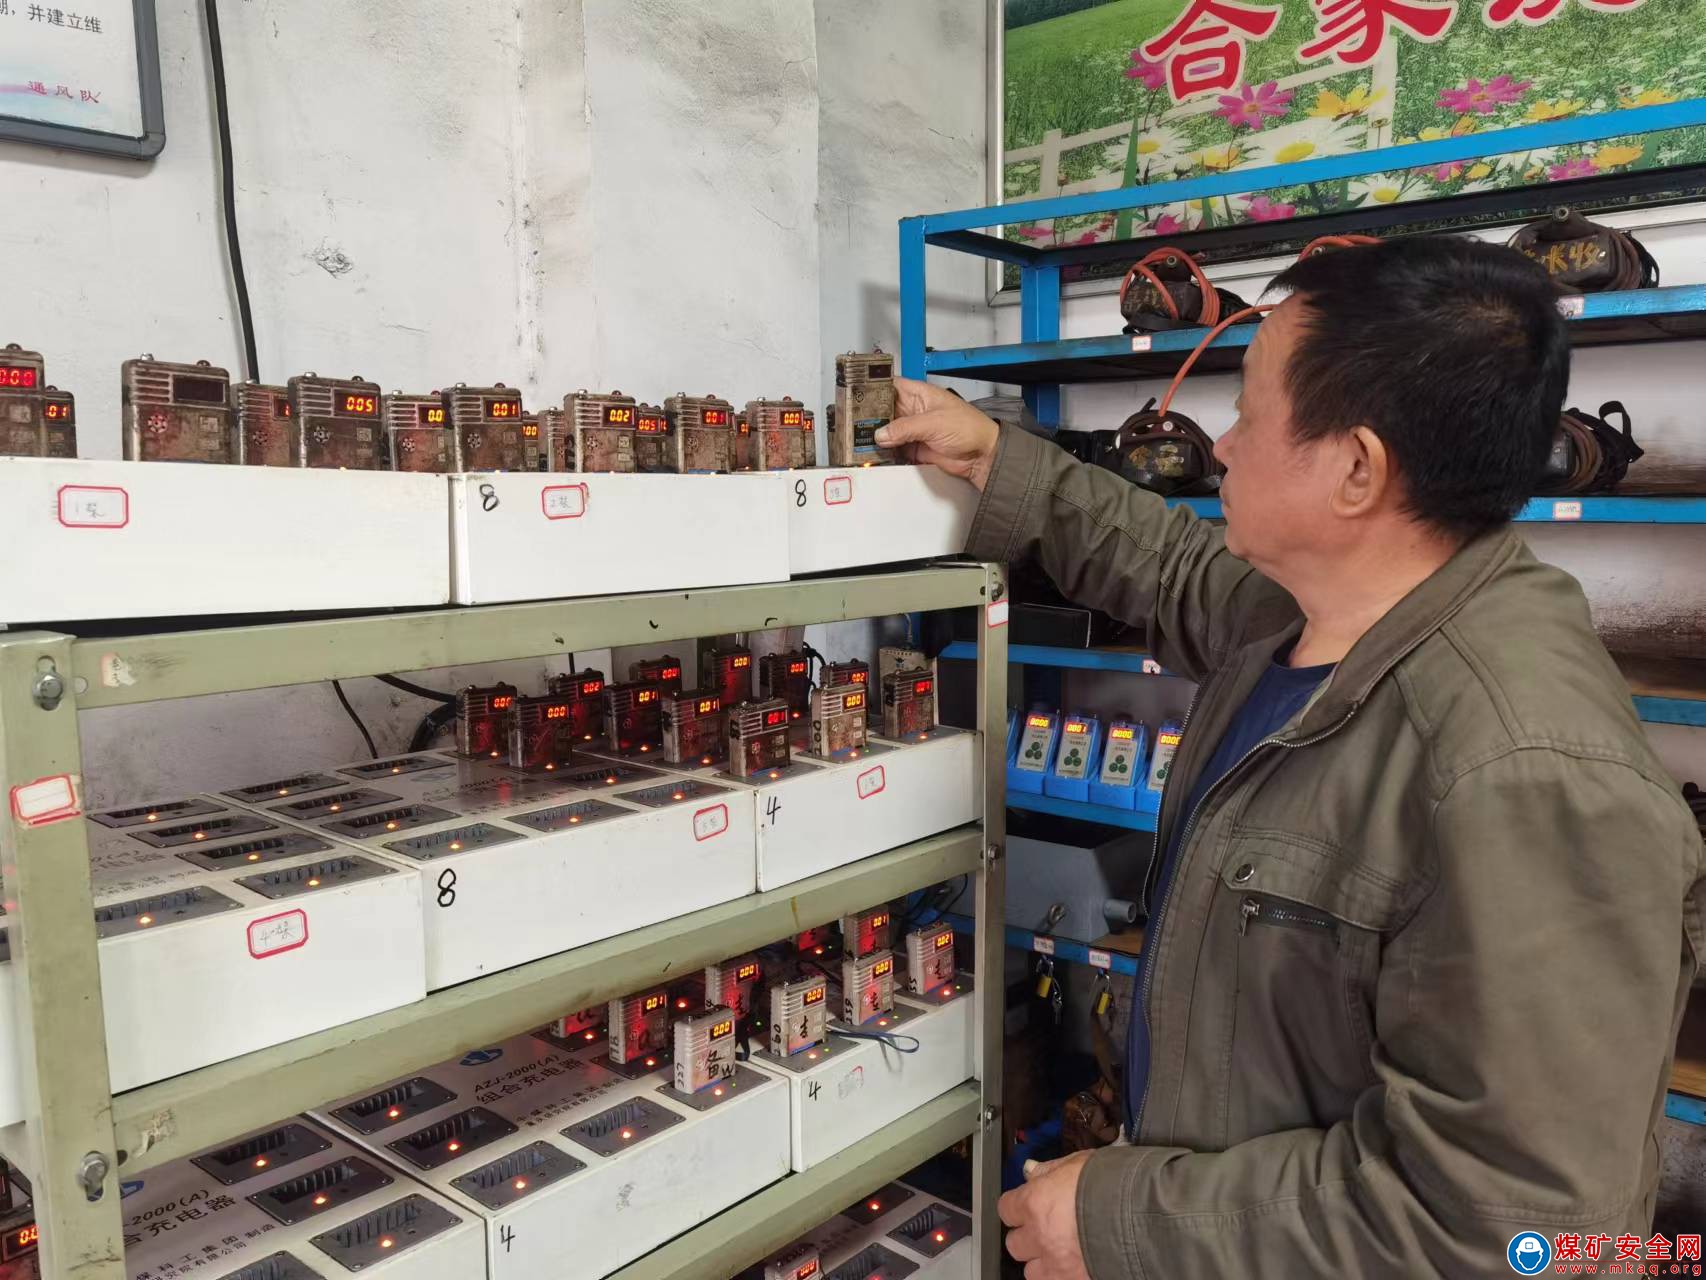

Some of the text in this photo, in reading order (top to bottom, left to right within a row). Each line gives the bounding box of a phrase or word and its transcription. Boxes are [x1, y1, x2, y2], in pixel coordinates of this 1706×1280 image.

[1141, 0, 1646, 102] 合家
[27, 80, 102, 104] 通风队
[479, 483, 500, 512] 8
[794, 479, 807, 507] 8
[766, 796, 782, 825] 4
[437, 868, 457, 908] 8
[808, 1081, 822, 1102] 4
[499, 1224, 516, 1253] 4
